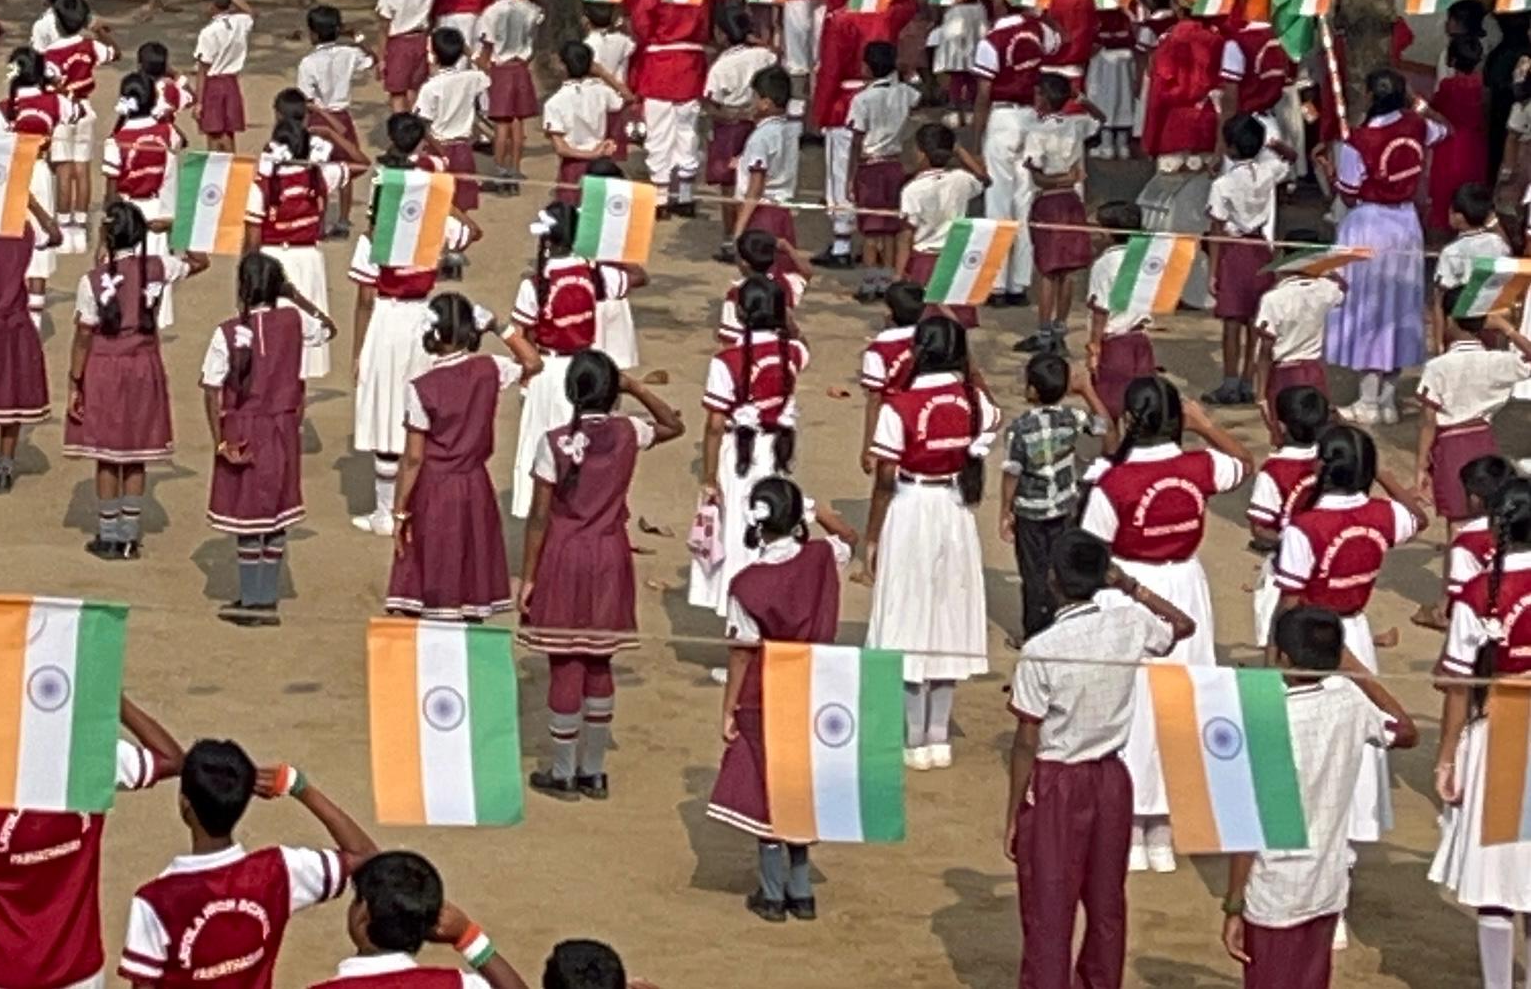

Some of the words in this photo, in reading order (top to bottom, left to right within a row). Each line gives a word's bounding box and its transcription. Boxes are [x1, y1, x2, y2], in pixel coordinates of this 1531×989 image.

[178, 916, 206, 970] LOYOLA
[202, 897, 237, 920] HIGH
[237, 898, 271, 941] SCHOOL
